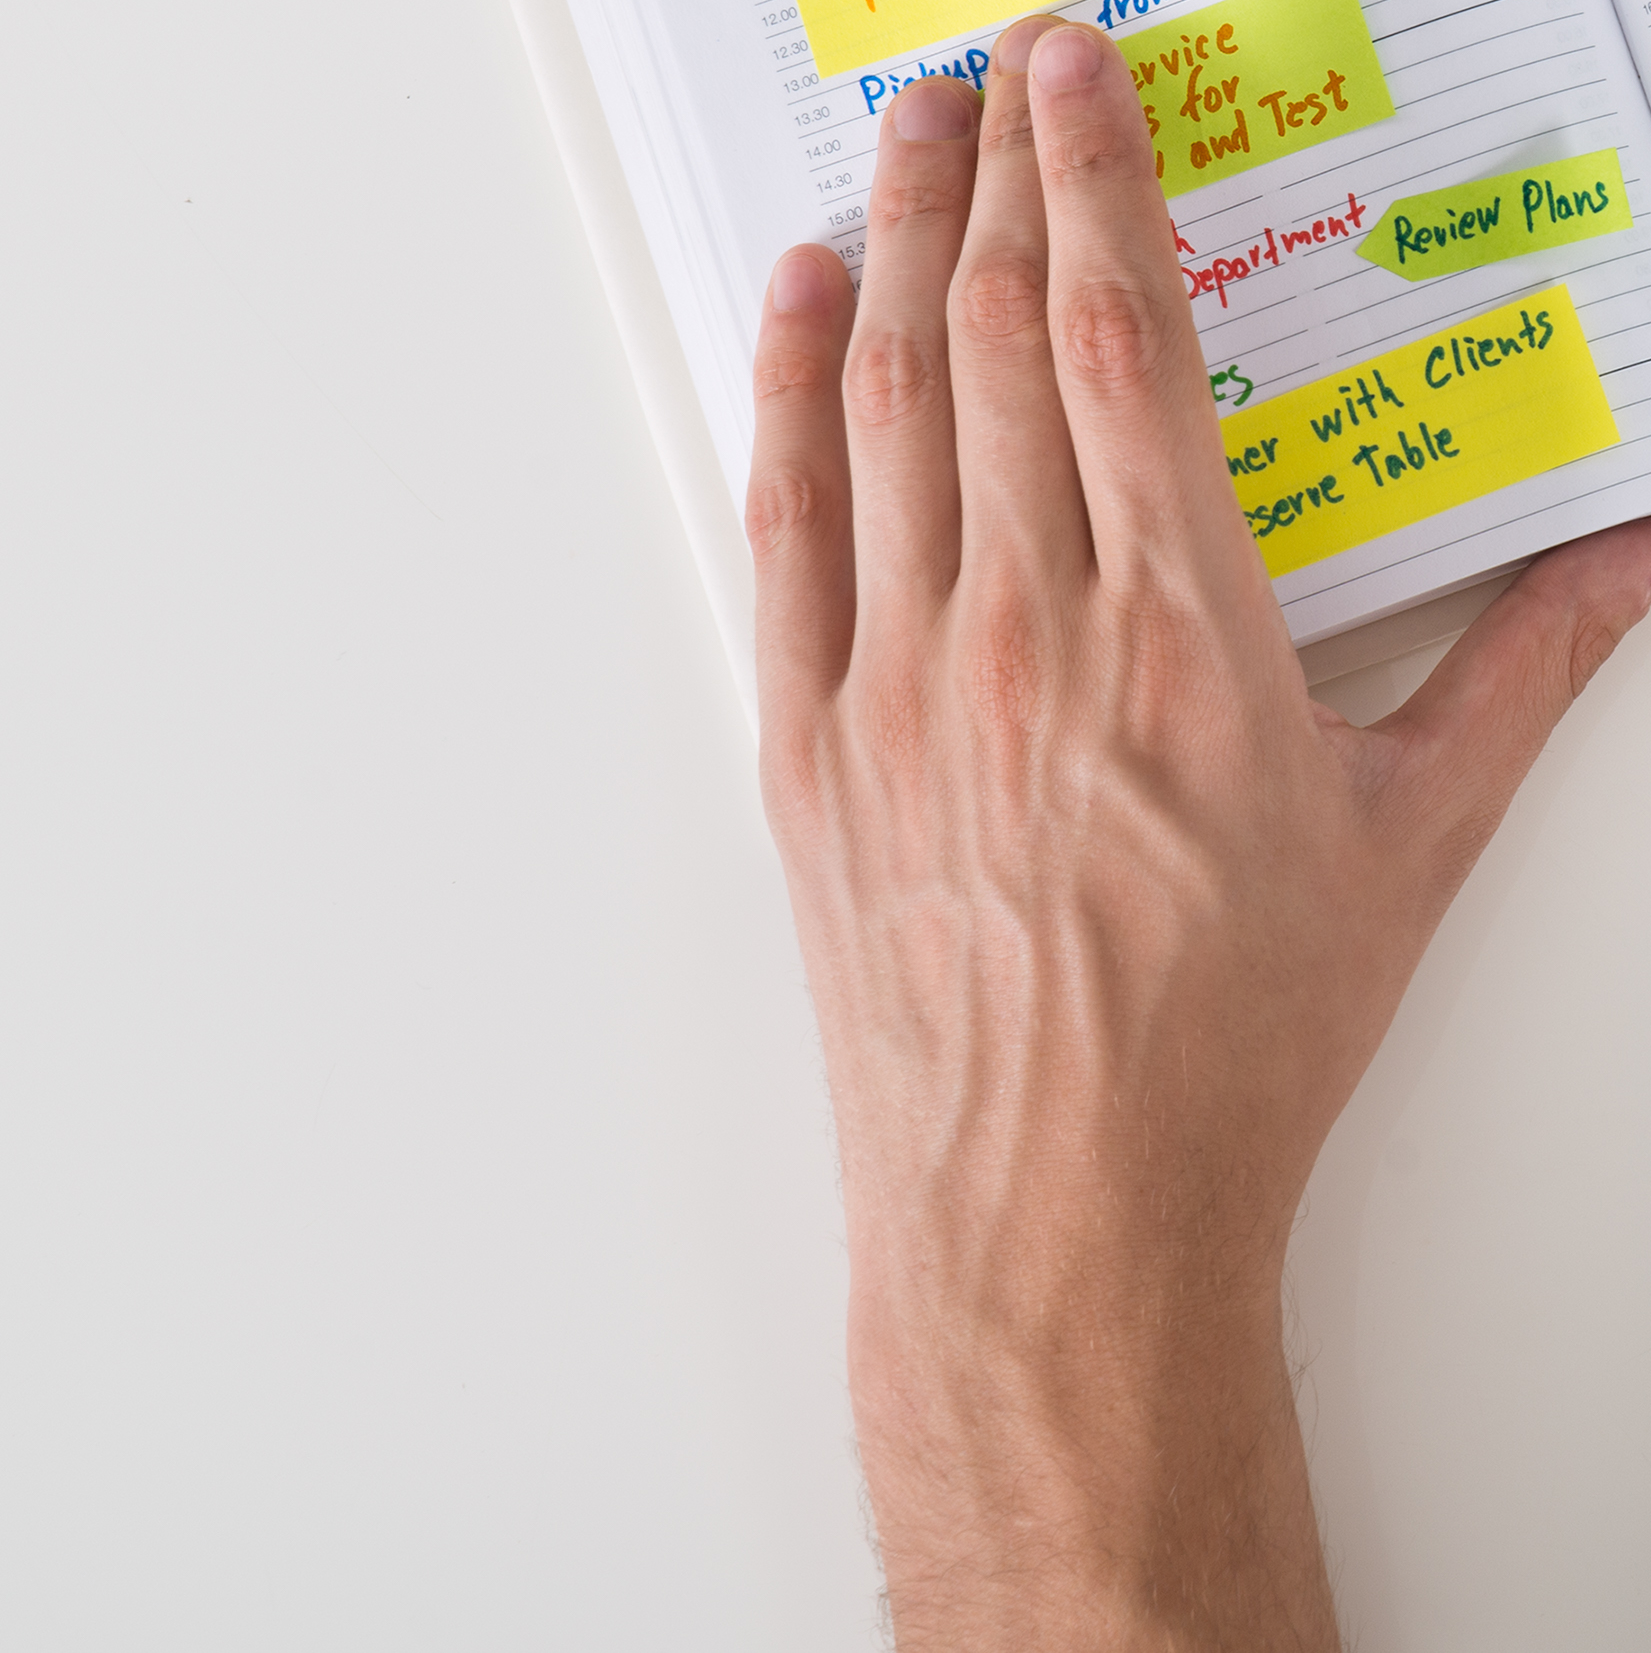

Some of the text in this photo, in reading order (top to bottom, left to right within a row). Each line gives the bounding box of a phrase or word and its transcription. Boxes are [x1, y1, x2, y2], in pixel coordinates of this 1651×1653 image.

[1130, 23, 1239, 92] ervice
[1180, 64, 1239, 122] for
[1190, 109, 1250, 169] and
[1258, 69, 1348, 137] Test
[828, 206, 863, 227] 15.00
[1393, 179, 1609, 264] Review Plans
[1310, 369, 1404, 443] with
[1424, 310, 1554, 389] Clients
[1352, 422, 1460, 487] Table
